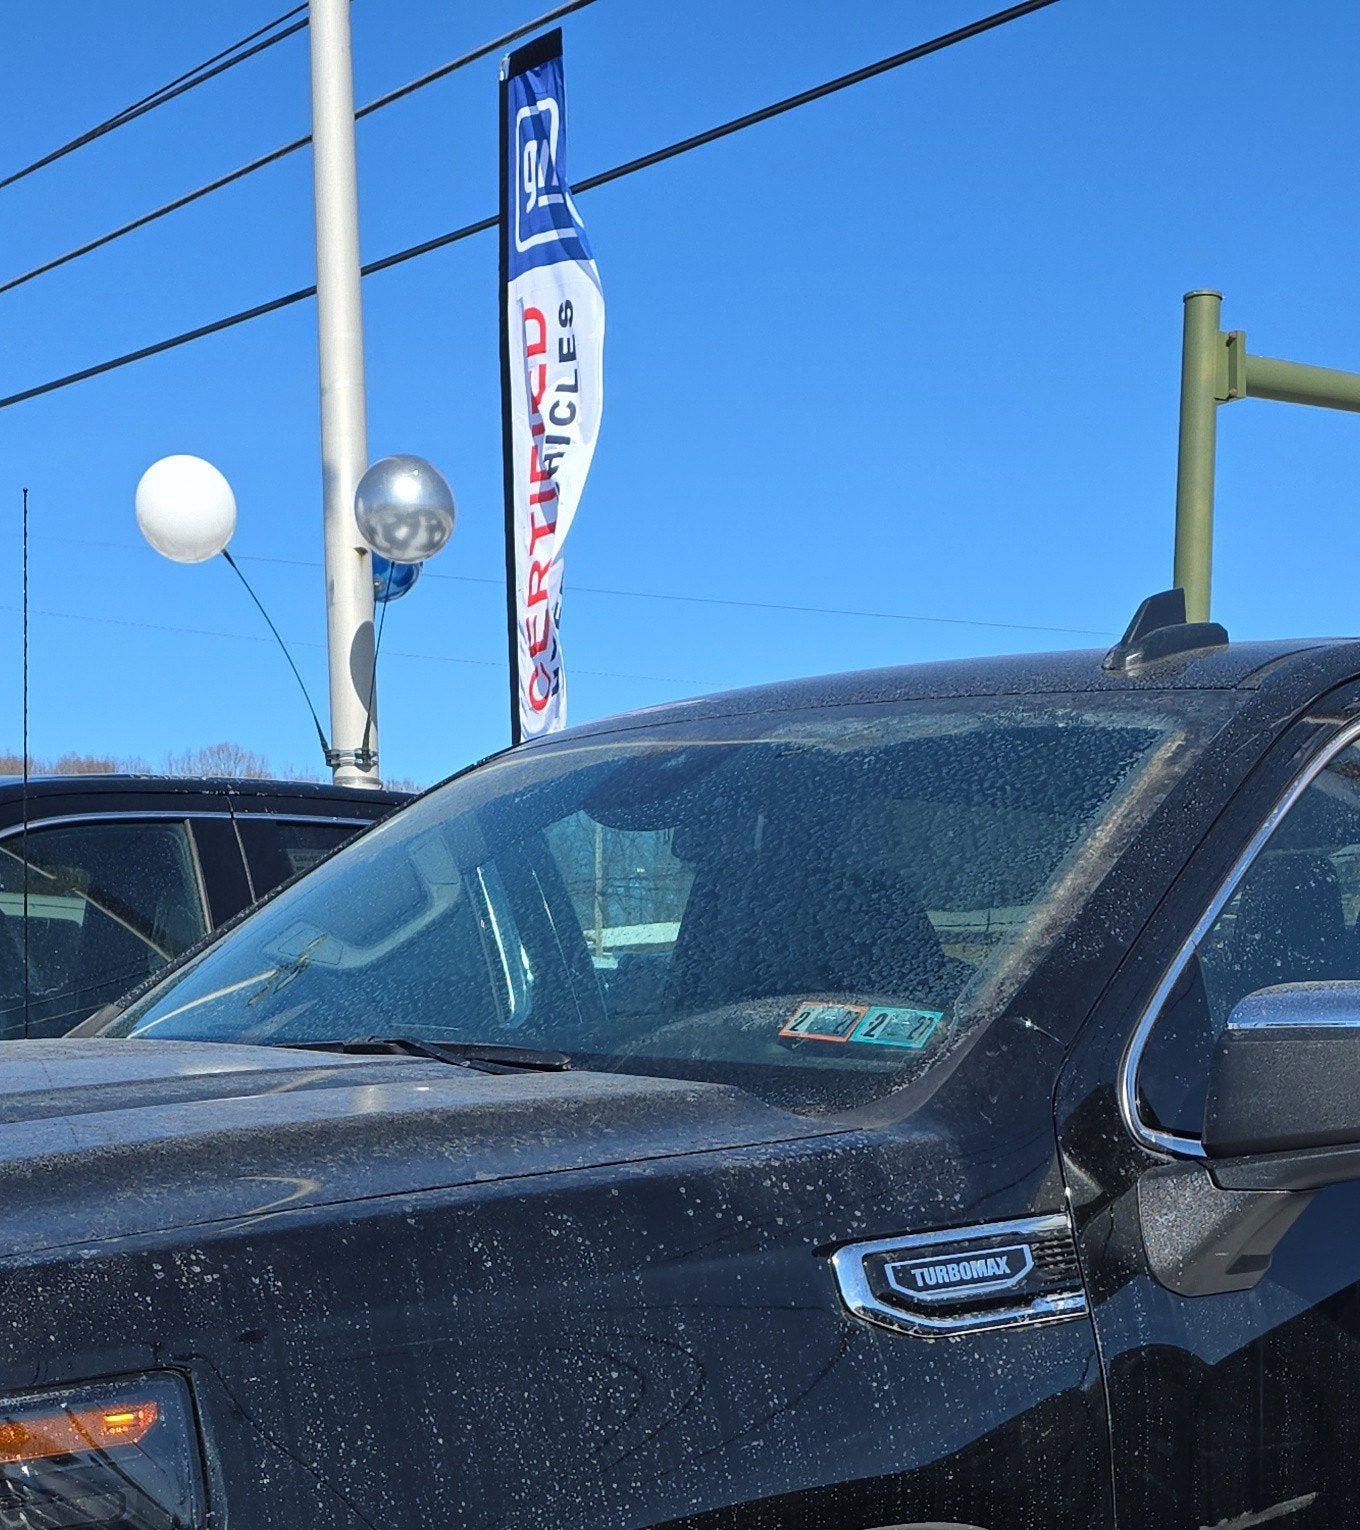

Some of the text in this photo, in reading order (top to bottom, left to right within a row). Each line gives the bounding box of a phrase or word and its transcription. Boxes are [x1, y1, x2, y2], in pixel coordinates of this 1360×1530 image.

[543, 300, 578, 480] HICLES
[790, 1011, 811, 1032] 2
[863, 1012, 889, 1038] 2
[911, 1256, 1011, 1287] TURBOMAX
